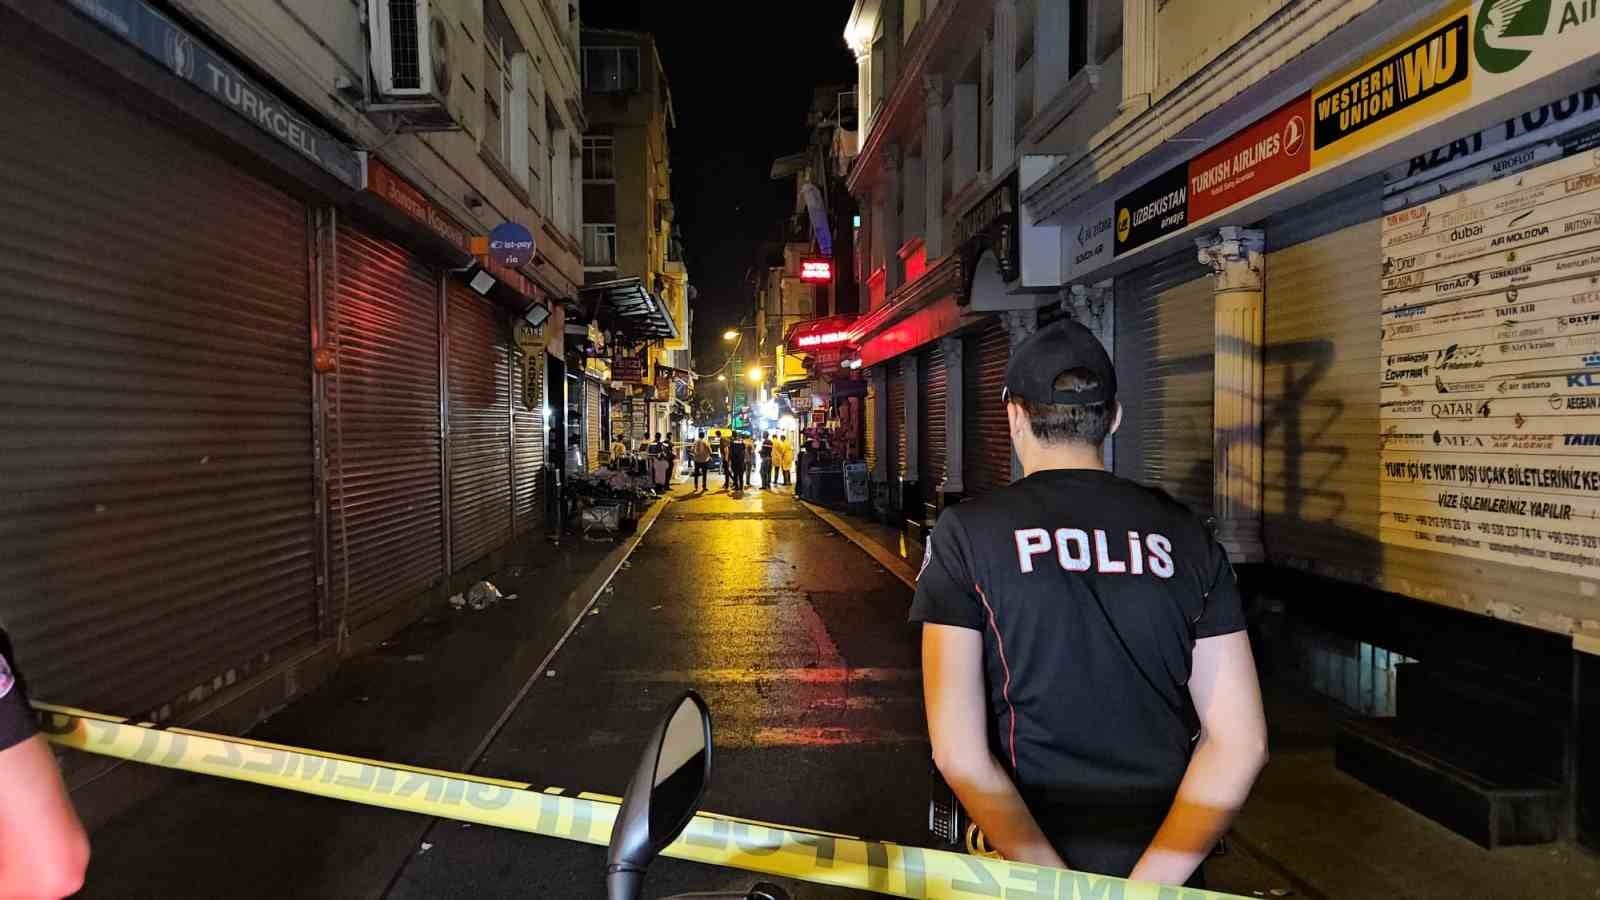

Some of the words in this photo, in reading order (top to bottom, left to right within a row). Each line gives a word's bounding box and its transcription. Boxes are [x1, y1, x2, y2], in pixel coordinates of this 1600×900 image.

[1404, 27, 1457, 99] WU
[1318, 64, 1394, 121] WESTERN
[207, 63, 321, 162] TURKCELL
[1339, 87, 1394, 131] UNION
[1191, 159, 1231, 196] TURKISH
[1232, 132, 1280, 176] AIRLINES
[1492, 152, 1535, 175] AEROFLOT
[1133, 186, 1187, 226] UZBEKISTAN
[1161, 211, 1185, 229] airways
[1450, 223, 1484, 242] dubai
[1506, 226, 1549, 243] MOLDOVA
[1496, 307, 1518, 318] TAJIK
[1519, 303, 1536, 314] AIR
[1521, 380, 1551, 389] astana
[1431, 402, 1473, 419] QATAR
[1566, 397, 1596, 409] AEGEAN
[1443, 436, 1484, 447] MEA
[1385, 462, 1406, 476] YURT
[1421, 463, 1432, 478] VE
[1433, 464, 1457, 480] YURT
[1459, 465, 1477, 487] DIŞI
[1479, 466, 1506, 488] UÇAK
[1507, 464, 1581, 490] BİLETLERİNİZ
[1582, 471, 1600, 490] KE
[1438, 492, 1458, 508] VİZE
[1459, 495, 1527, 515] İŞLEMLERİNİZ
[1529, 503, 1571, 520] YAPILIR
